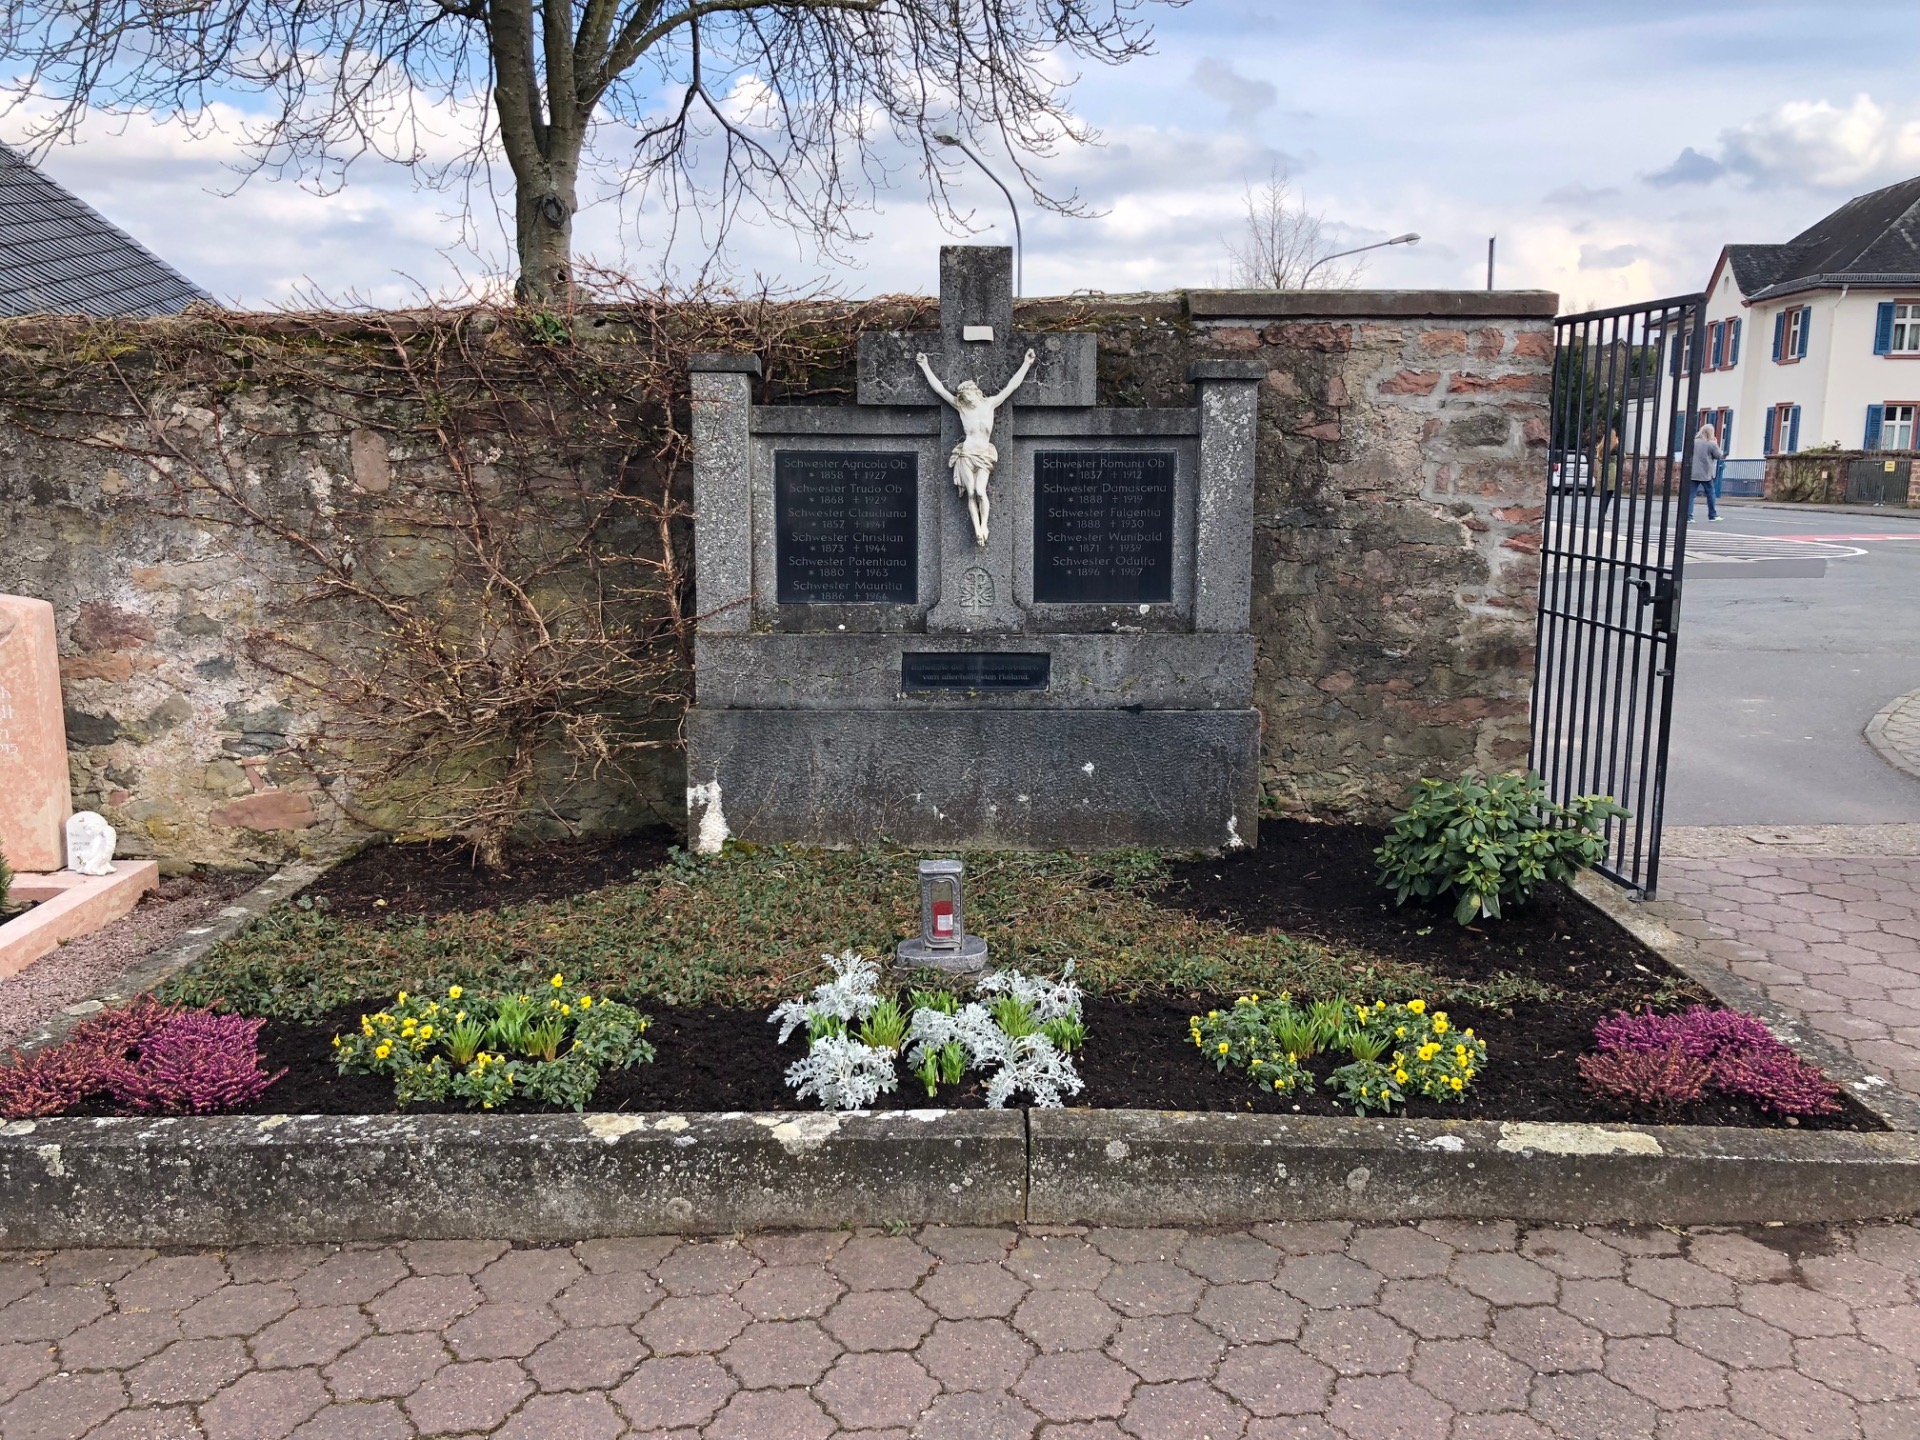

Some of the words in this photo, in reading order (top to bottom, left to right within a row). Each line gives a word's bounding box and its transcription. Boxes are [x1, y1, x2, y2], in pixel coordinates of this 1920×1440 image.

[784, 458, 839, 468] Schwester
[842, 459, 887, 470] Agricola
[1043, 459, 1097, 469] Schwester
[1100, 458, 1145, 468] Romana
[821, 471, 844, 479] 1858
[864, 471, 887, 480] 1927
[1080, 471, 1102, 479] 1837
[1123, 471, 1142, 479] 1912
[789, 483, 846, 493] Schwester
[849, 483, 882, 493] Trudo
[1043, 484, 1098, 493] Schwester
[1102, 483, 1167, 492] Damascena
[820, 496, 844, 504] 1868
[864, 496, 887, 504] 1929
[1080, 495, 1103, 504] 1888
[1124, 495, 1143, 504] 1919
[787, 508, 844, 518] Schwester
[848, 508, 907, 518] Claudiana
[1048, 508, 1105, 518] Schwester
[1110, 507, 1161, 518] Fulgentia
[1077, 520, 1100, 528] 1888
[1121, 520, 1144, 528] 1930
[791, 532, 849, 542] Schwester
[852, 532, 903, 542] Christian
[1047, 532, 1103, 542] Schwester
[1108, 532, 1162, 541] Wunibald
[822, 544, 844, 553] 1873
[865, 544, 887, 553] 1944
[1080, 544, 1100, 552] 1871
[1120, 544, 1142, 552] 1939
[789, 556, 844, 566] Schwester
[848, 557, 907, 566] Potentiana
[1052, 556, 1111, 566] Schwester
[1115, 556, 1155, 566] Odulfa
[820, 568, 844, 577] 1880
[866, 568, 888, 577] 1963
[1078, 568, 1100, 576] 1896
[1121, 568, 1143, 576] 1967
[793, 581, 850, 590] Schwester
[854, 581, 903, 590] Mauritia
[821, 592, 845, 600] 1886
[866, 592, 888, 600] 1964
